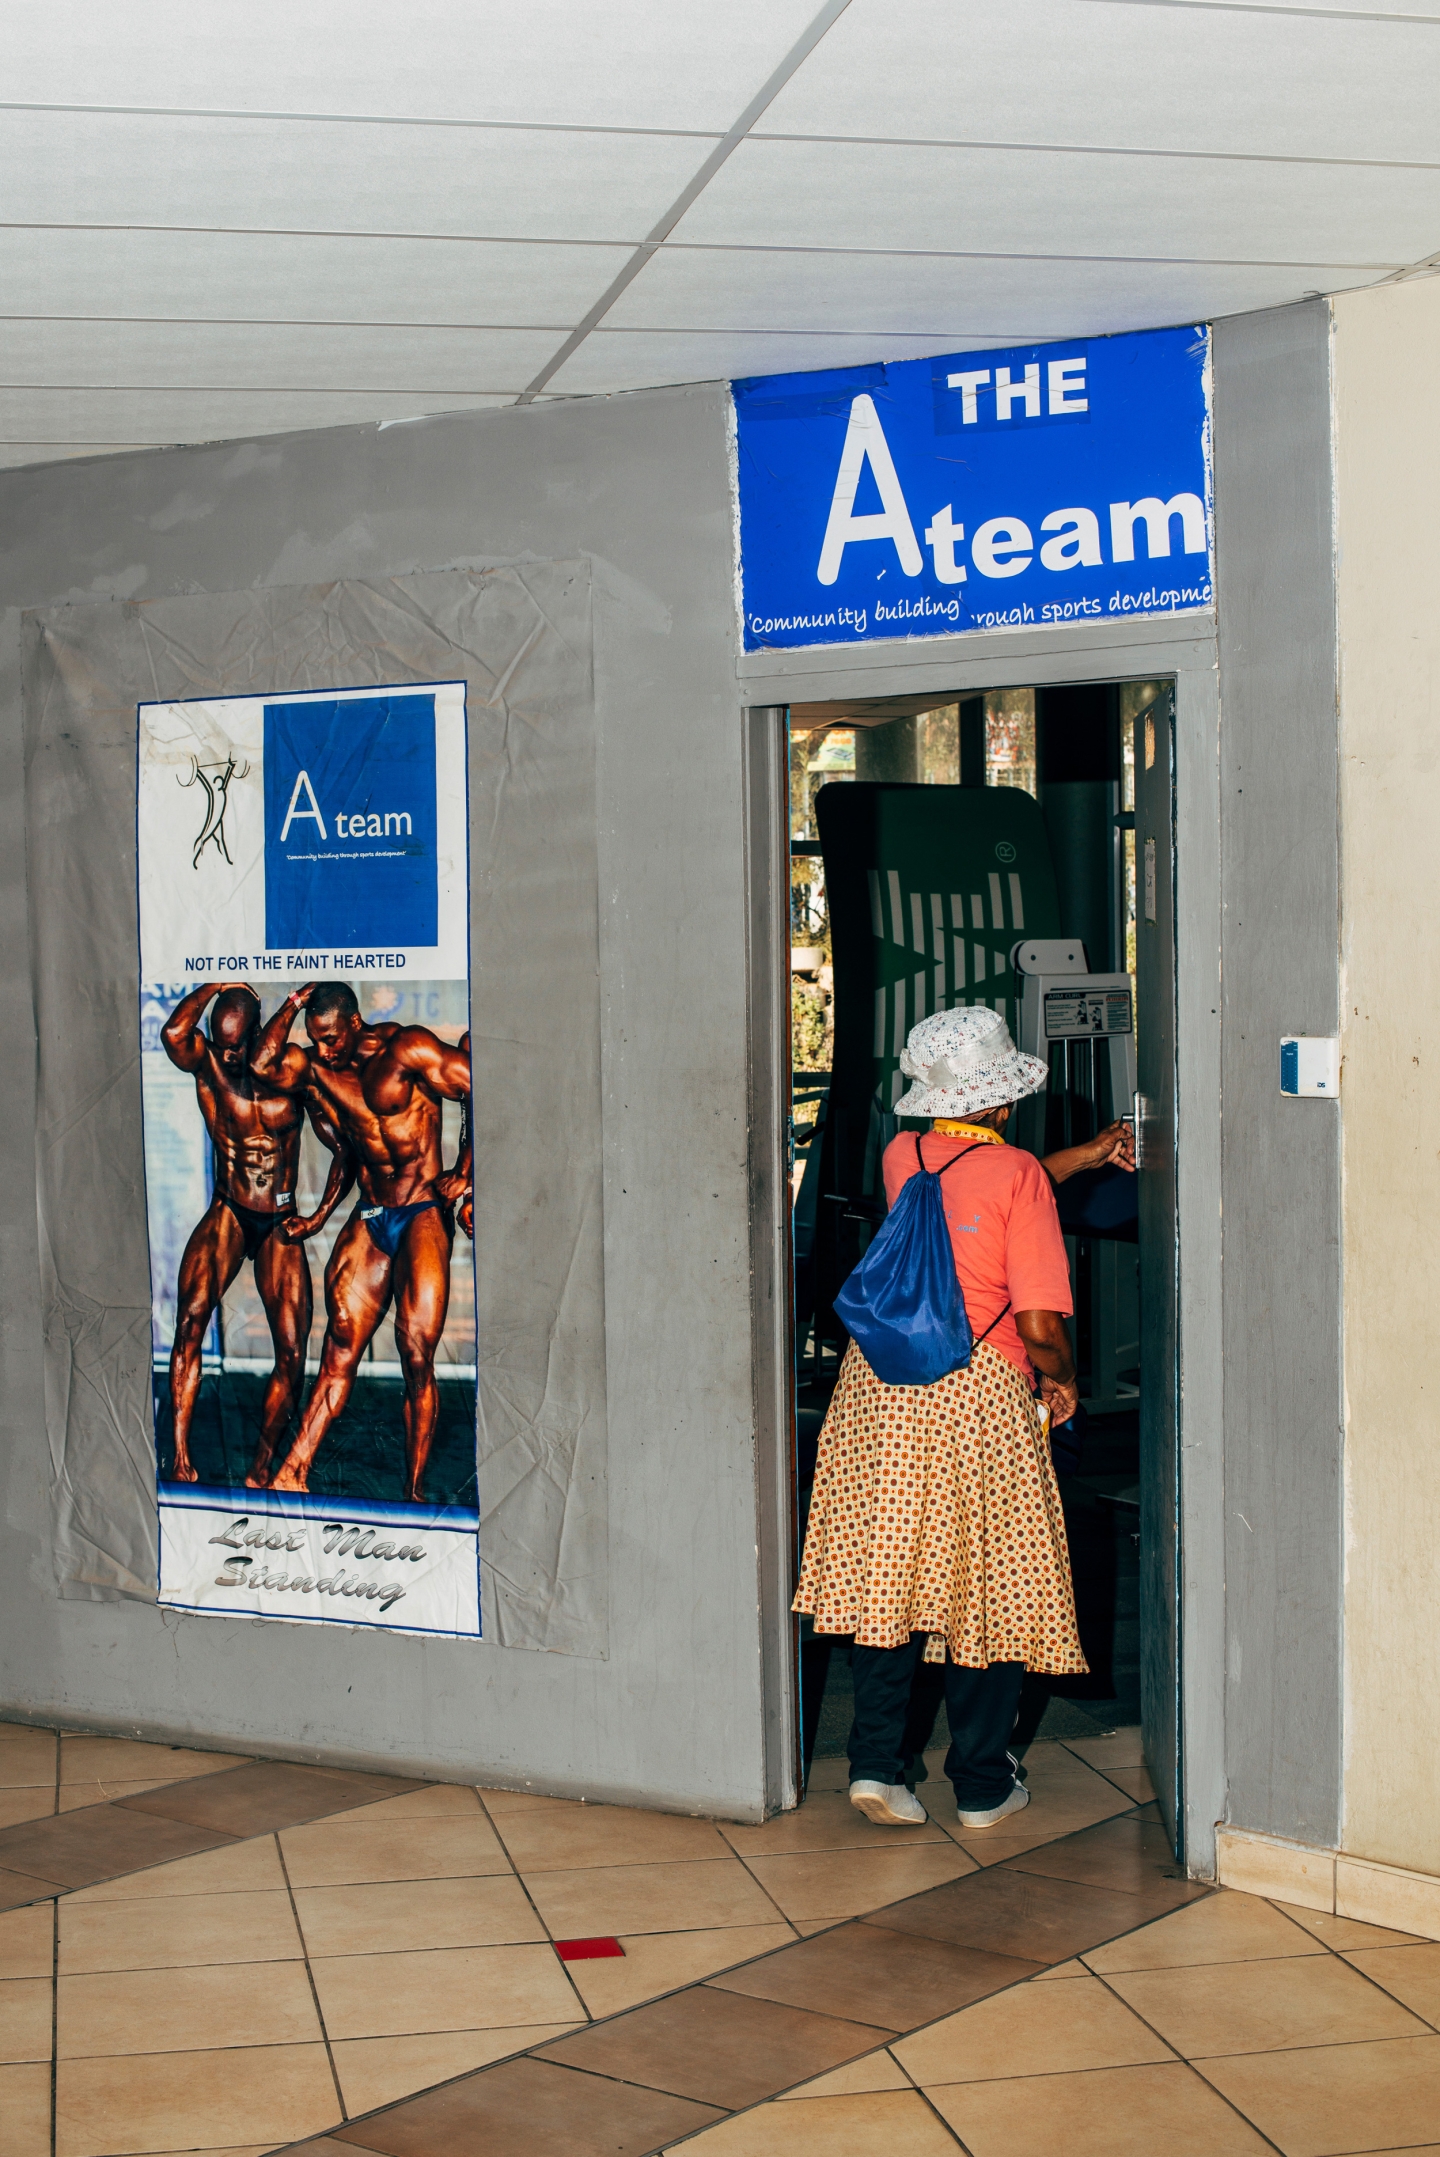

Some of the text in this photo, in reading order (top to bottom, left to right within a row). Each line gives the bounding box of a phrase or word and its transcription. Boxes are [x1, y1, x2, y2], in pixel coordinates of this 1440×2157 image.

[947, 357, 1089, 425] THE
[817, 393, 1207, 586] A team
[874, 595, 960, 621] building
[971, 602, 1035, 626] rough
[1041, 597, 1102, 623] sports
[279, 770, 413, 842] A team
[339, 850, 360, 859] through
[359, 850, 375, 859] sports
[184, 953, 407, 971] NOT FOR THE FAINT HEARTED
[208, 1517, 428, 1563] Last Man
[214, 1555, 407, 1613] Standing
